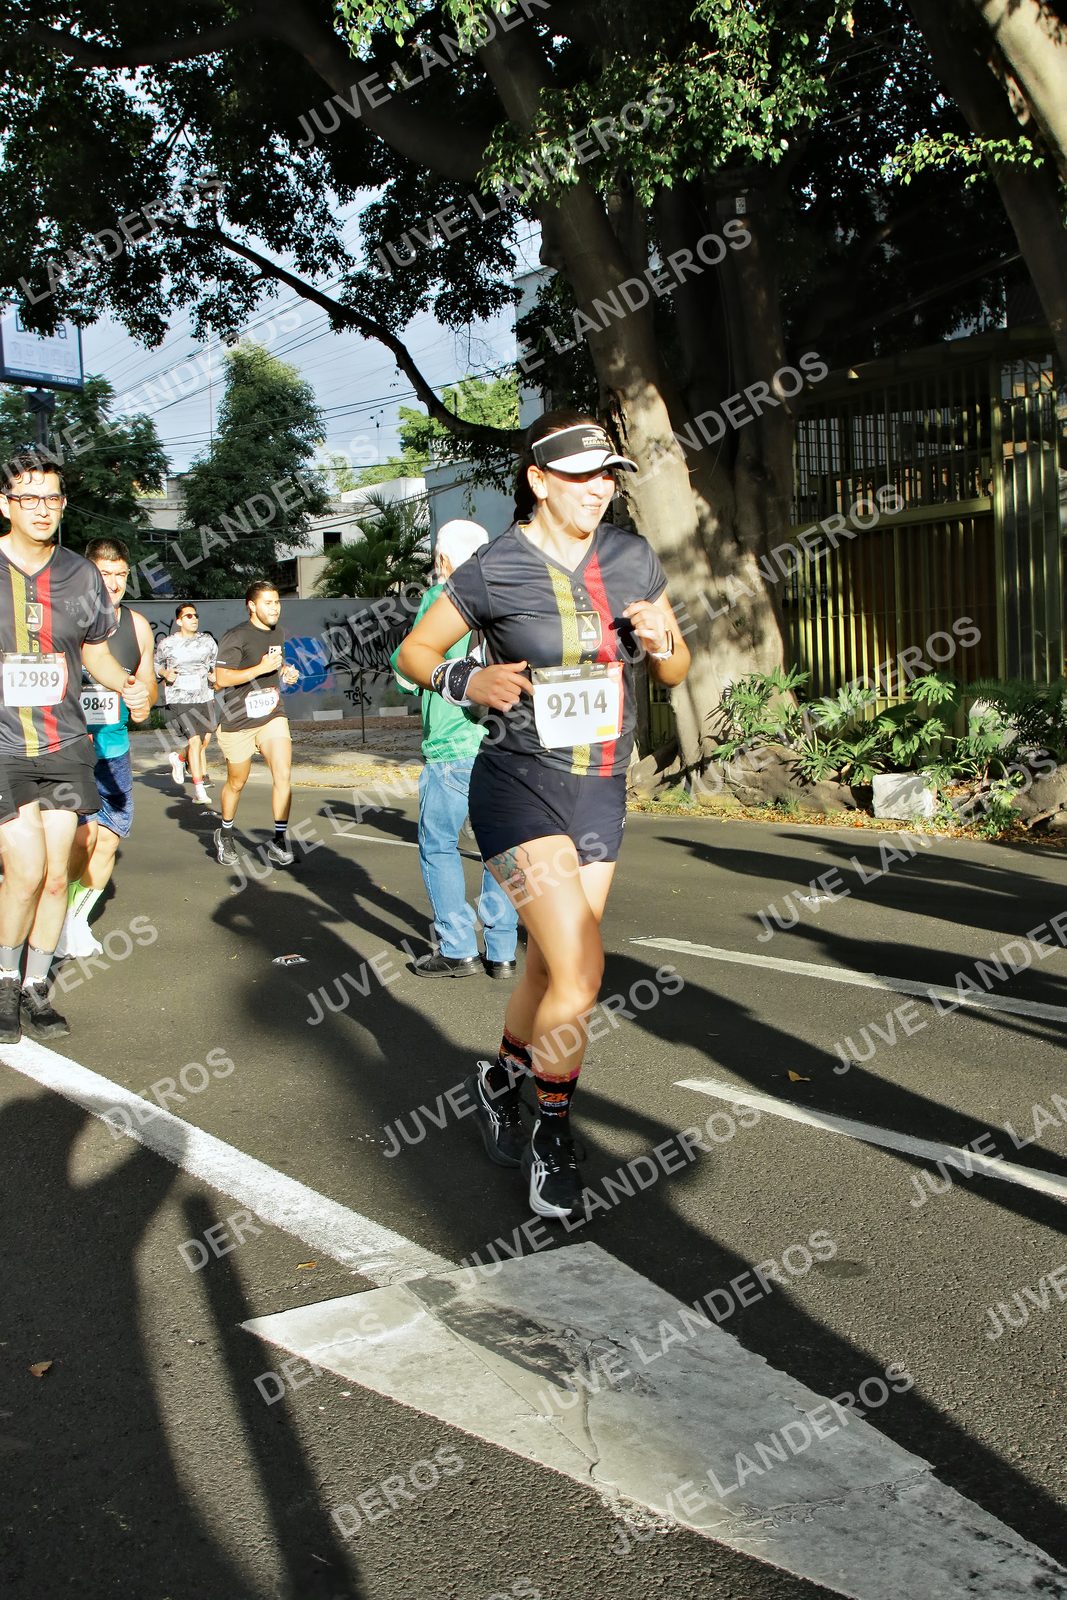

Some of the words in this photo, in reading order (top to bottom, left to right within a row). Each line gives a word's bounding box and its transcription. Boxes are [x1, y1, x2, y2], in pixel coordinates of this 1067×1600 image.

[7, 671, 60, 688] 12989
[82, 697, 114, 711] 9845
[547, 688, 608, 719] 9214
